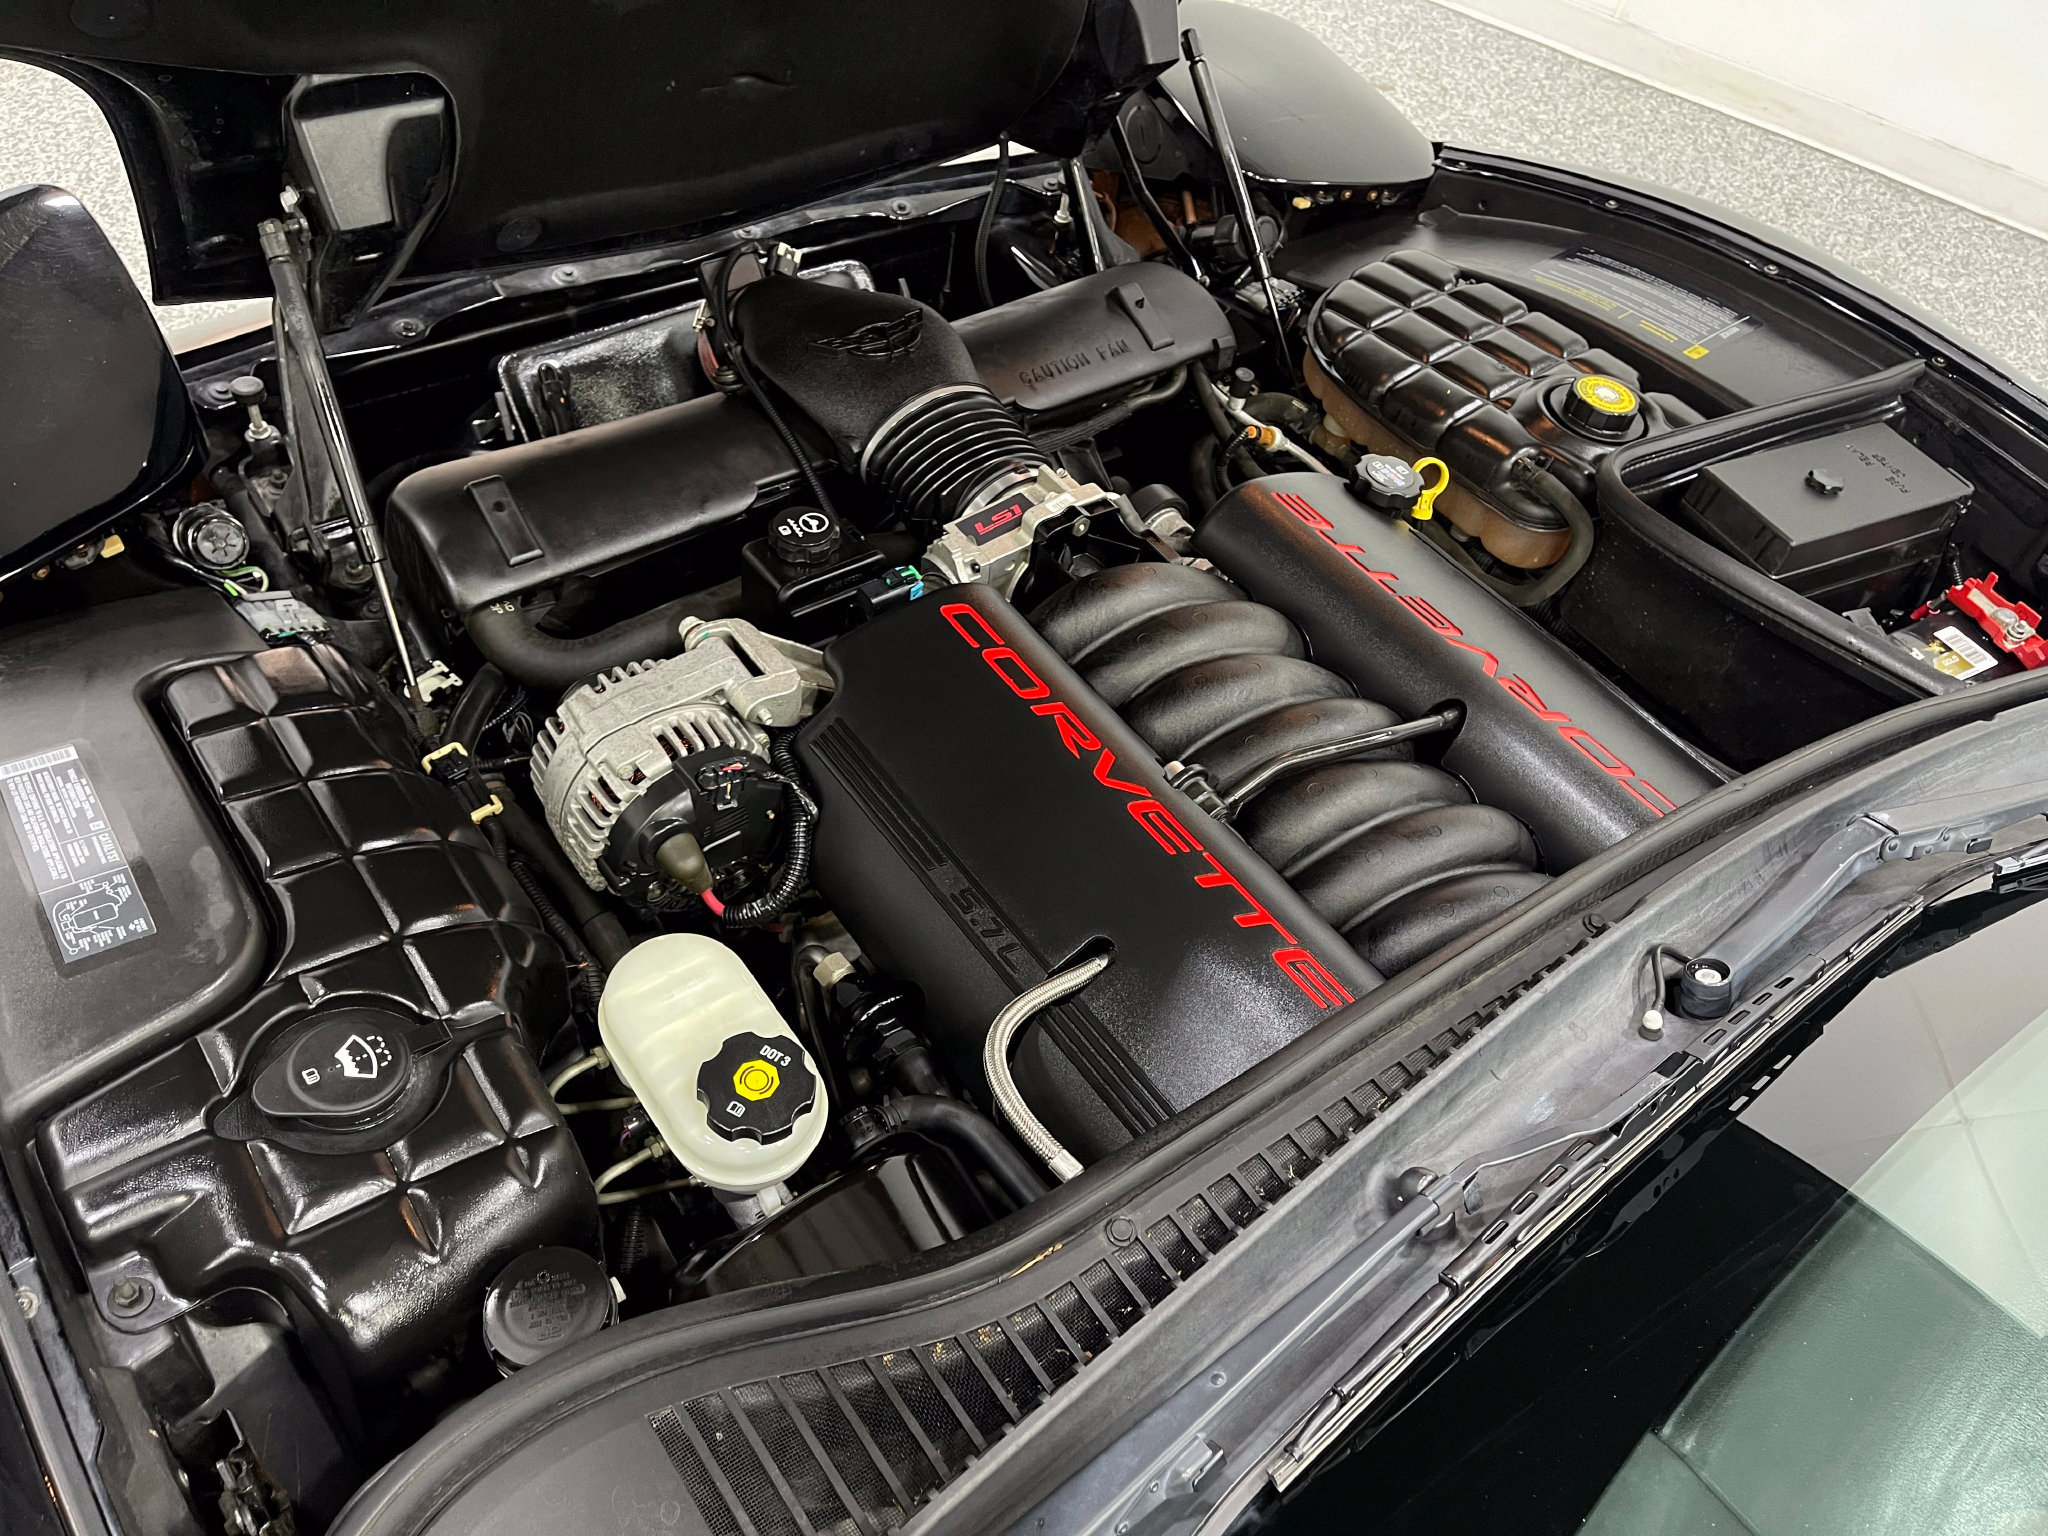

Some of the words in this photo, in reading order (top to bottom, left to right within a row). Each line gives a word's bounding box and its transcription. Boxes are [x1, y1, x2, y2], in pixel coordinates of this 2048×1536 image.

[1018, 351, 1092, 386] CAUTION
[1096, 338, 1131, 361] FAN
[974, 504, 1023, 535] LS1
[940, 602, 1356, 1009] CORVETTE
[98, 832, 120, 864] CATALYST
[949, 887, 1021, 974] 5.7L
[759, 1044, 785, 1063] DOT
[780, 1055, 792, 1067] 3
